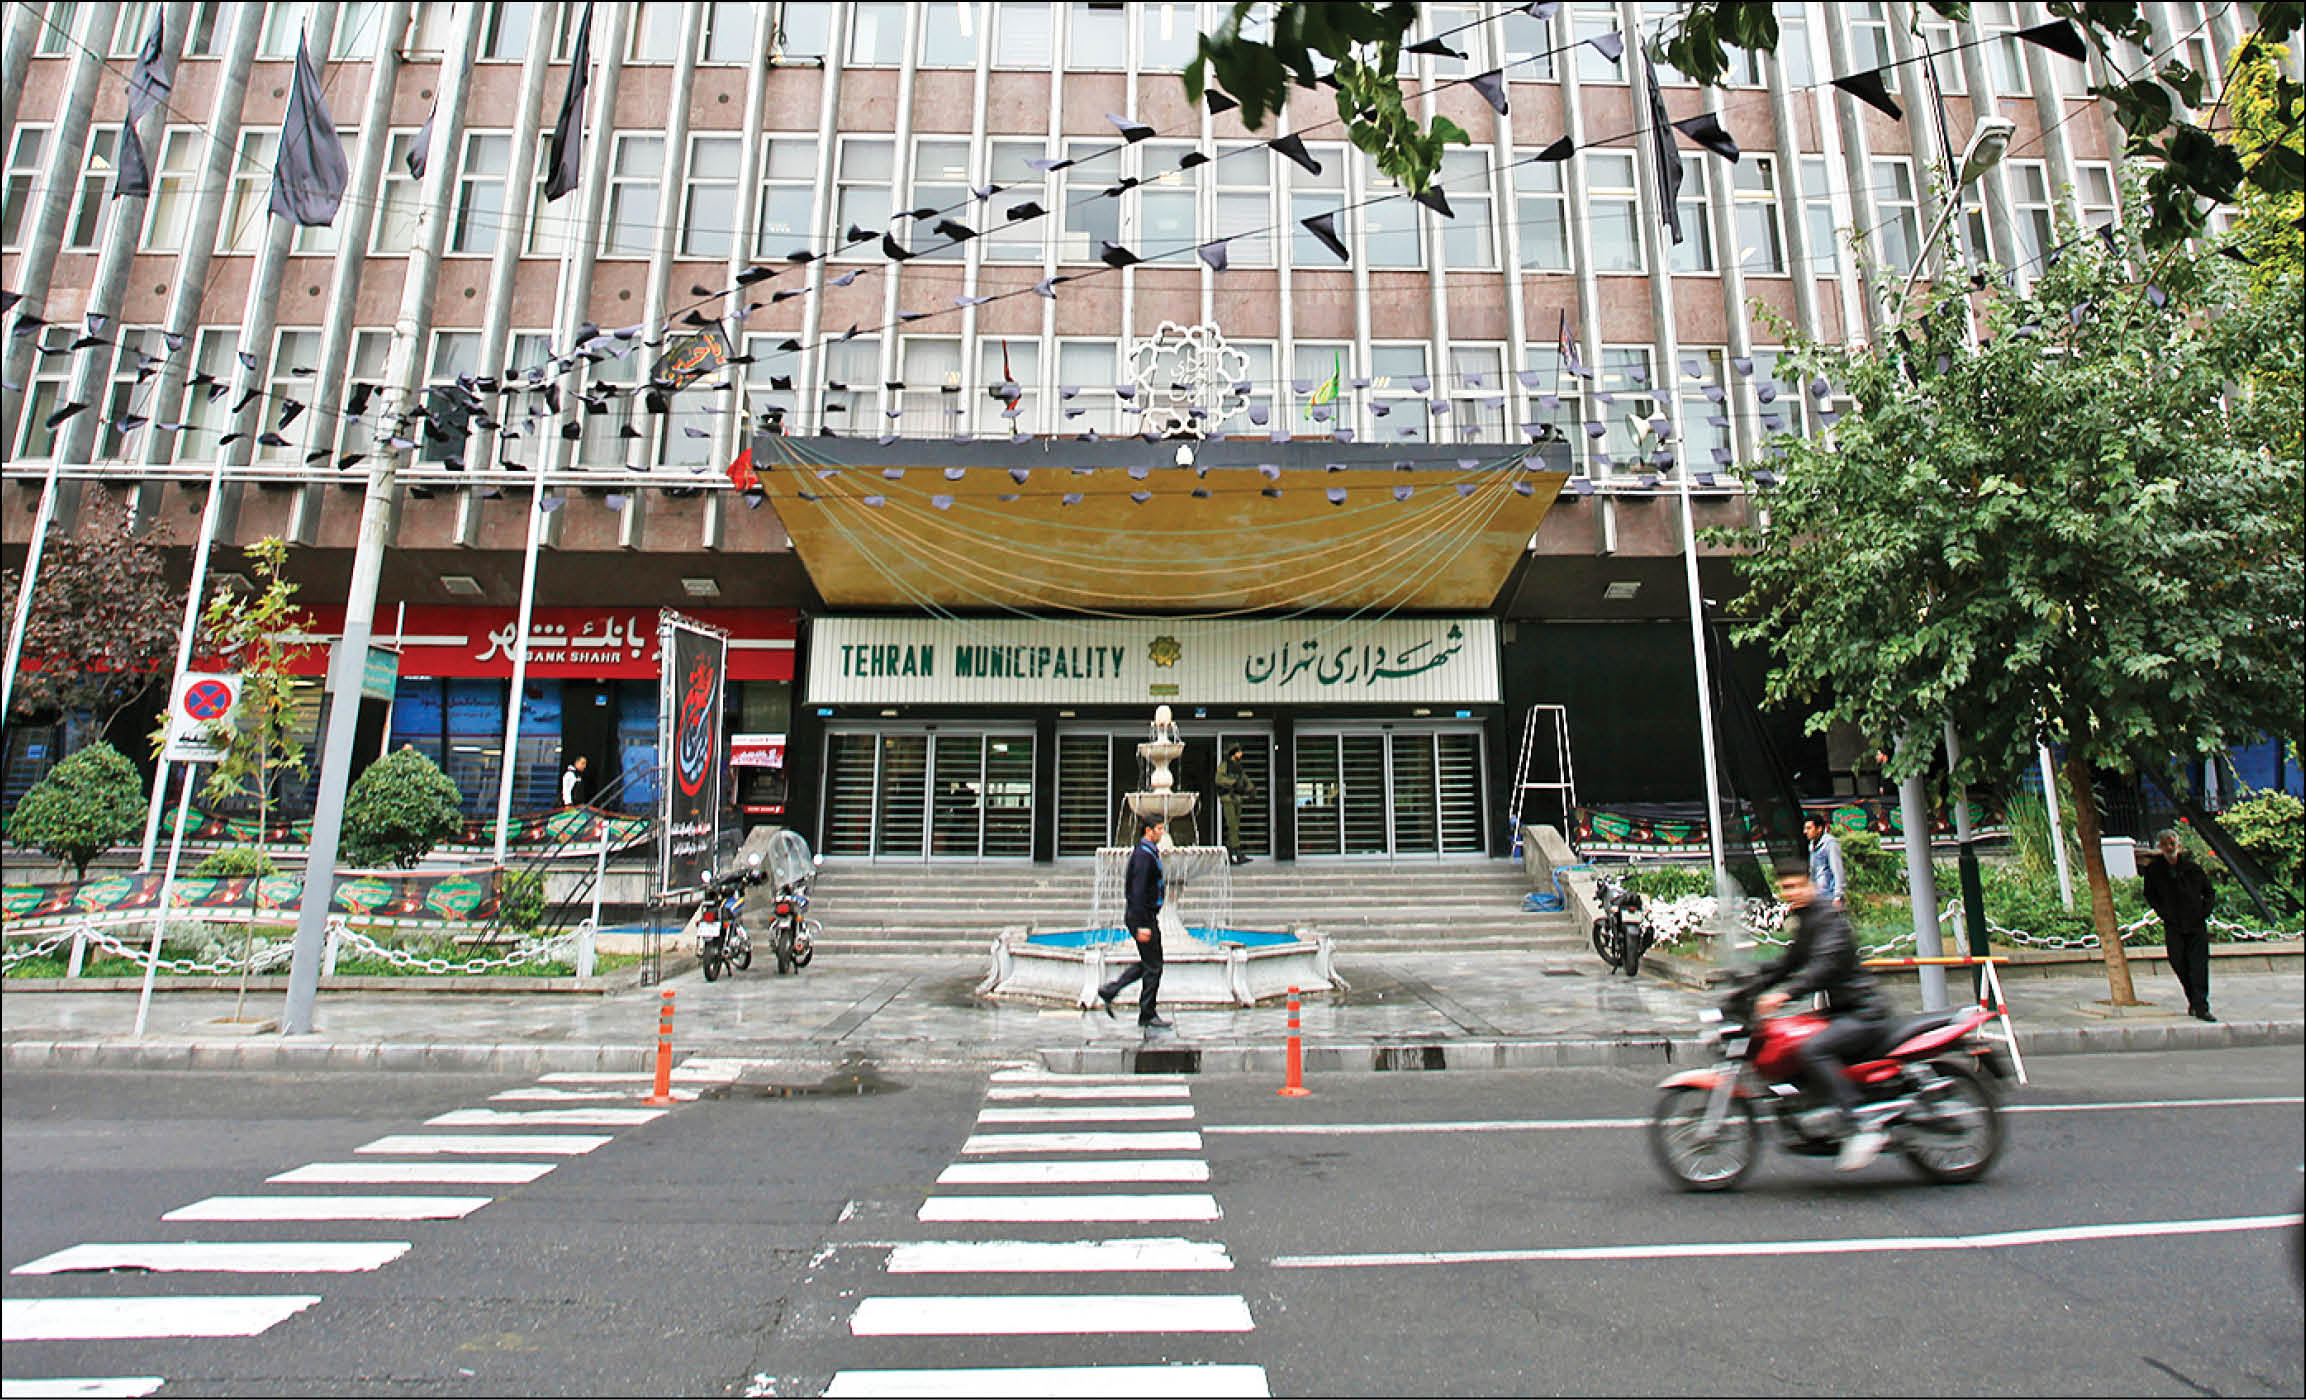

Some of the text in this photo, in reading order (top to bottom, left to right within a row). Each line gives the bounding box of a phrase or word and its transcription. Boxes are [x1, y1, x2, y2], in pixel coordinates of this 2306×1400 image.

[569, 651, 621, 663] SHAHR
[840, 645, 1125, 679] TEHRAN MUNICIPALITY
[1245, 624, 1464, 686] شهرداری تهران
